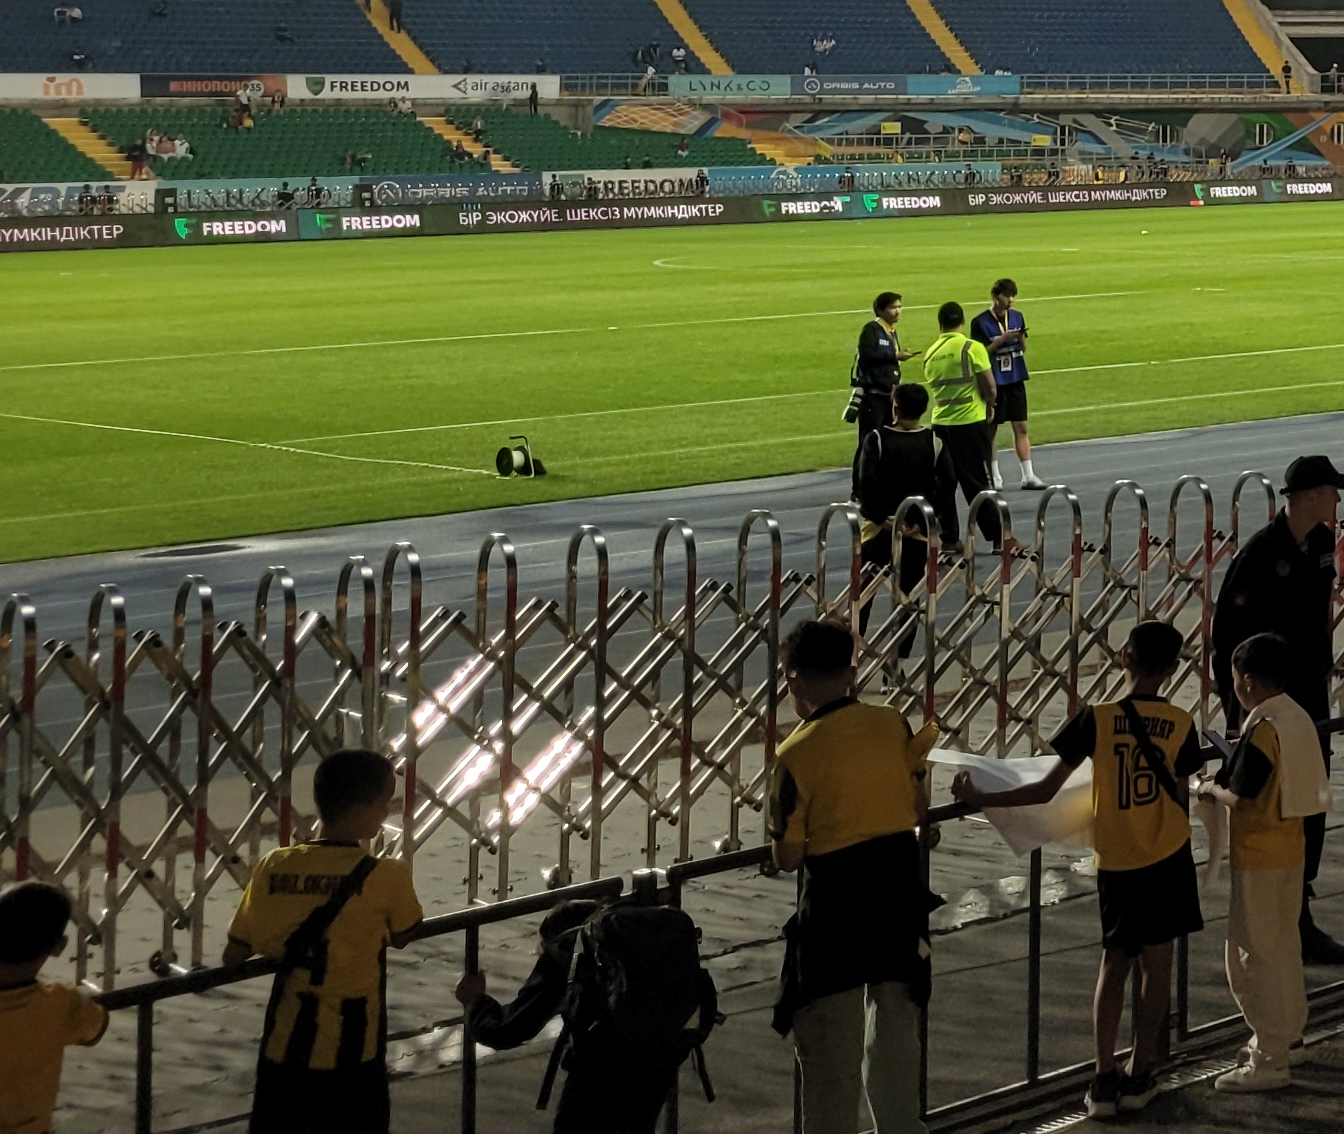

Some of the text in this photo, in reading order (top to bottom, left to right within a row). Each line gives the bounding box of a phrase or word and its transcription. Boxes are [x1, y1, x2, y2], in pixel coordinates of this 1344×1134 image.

[249, 83, 262, 92] 35
[330, 80, 410, 92] FREEDOM
[471, 78, 489, 92] air
[500, 84, 512, 94] 36
[823, 81, 895, 89] ORBIS AUTO
[1210, 185, 1257, 198] FREEDOM
[1287, 182, 1332, 195] FREEDOM
[882, 195, 941, 209] FREEDOM
[968, 188, 1167, 206] БІР ЭКОЖҮЙЕ. ШЕКСІЗ МҮМКІНДІКТЕР
[781, 200, 843, 215] FREEDOM
[459, 204, 724, 226] БІР ЭКОЖҮЙЕ. ШЕКСІЗ МҮМКІНДІКТЕР
[202, 219, 287, 236] FREEDOM
[341, 214, 421, 231] FREEDOM
